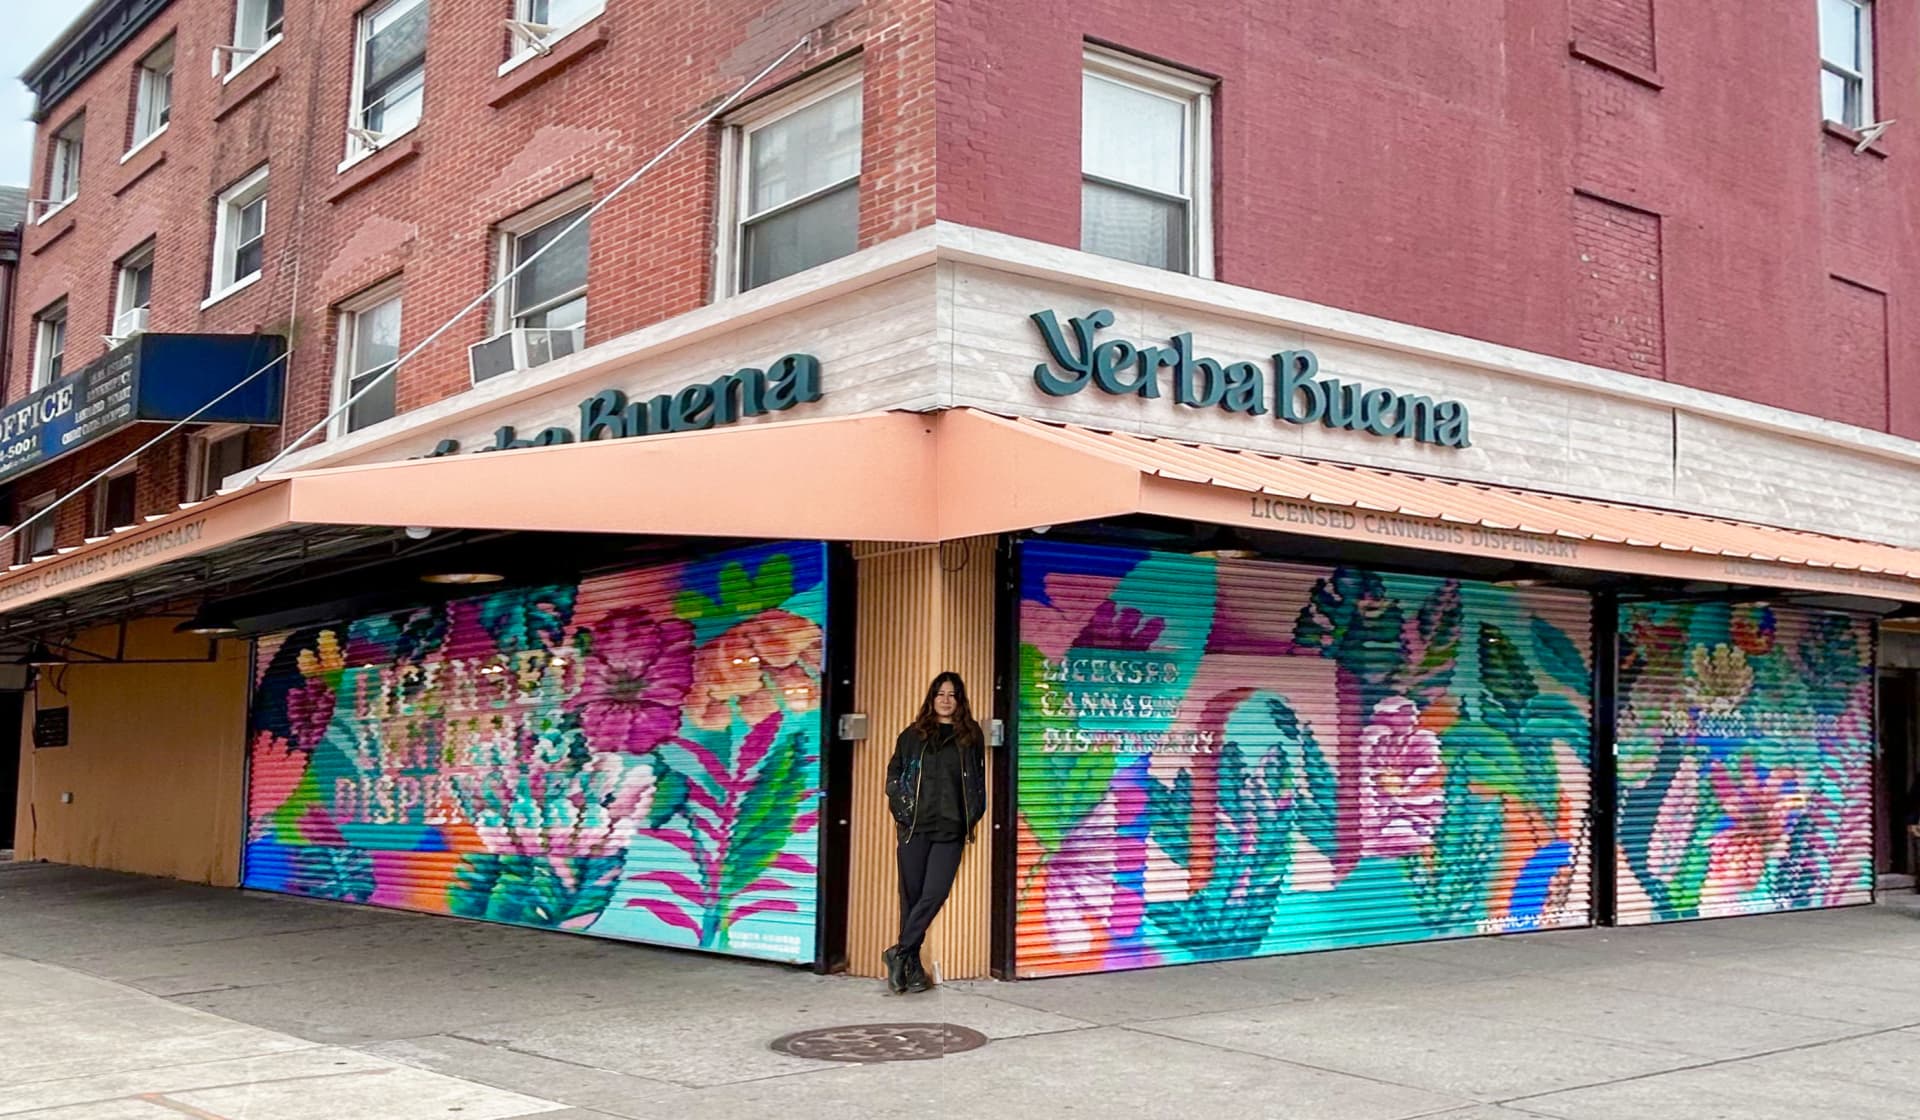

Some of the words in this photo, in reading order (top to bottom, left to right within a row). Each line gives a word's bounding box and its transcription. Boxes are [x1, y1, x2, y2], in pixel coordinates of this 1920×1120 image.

[578, 353, 823, 443] Buena
[1030, 308, 1268, 416] Yerba
[1272, 349, 1472, 449] Buena
[0, 383, 73, 443] FFICE
[43, 557, 109, 589] CANNABIS
[111, 518, 207, 567] DISPENSARY
[1251, 496, 1356, 530] LICENSED
[1364, 513, 1466, 545] CANNABIS
[1470, 525, 1581, 559] DISPENSARY
[1041, 658, 1179, 684] LICENSED
[1040, 690, 1182, 718] CANNABIS
